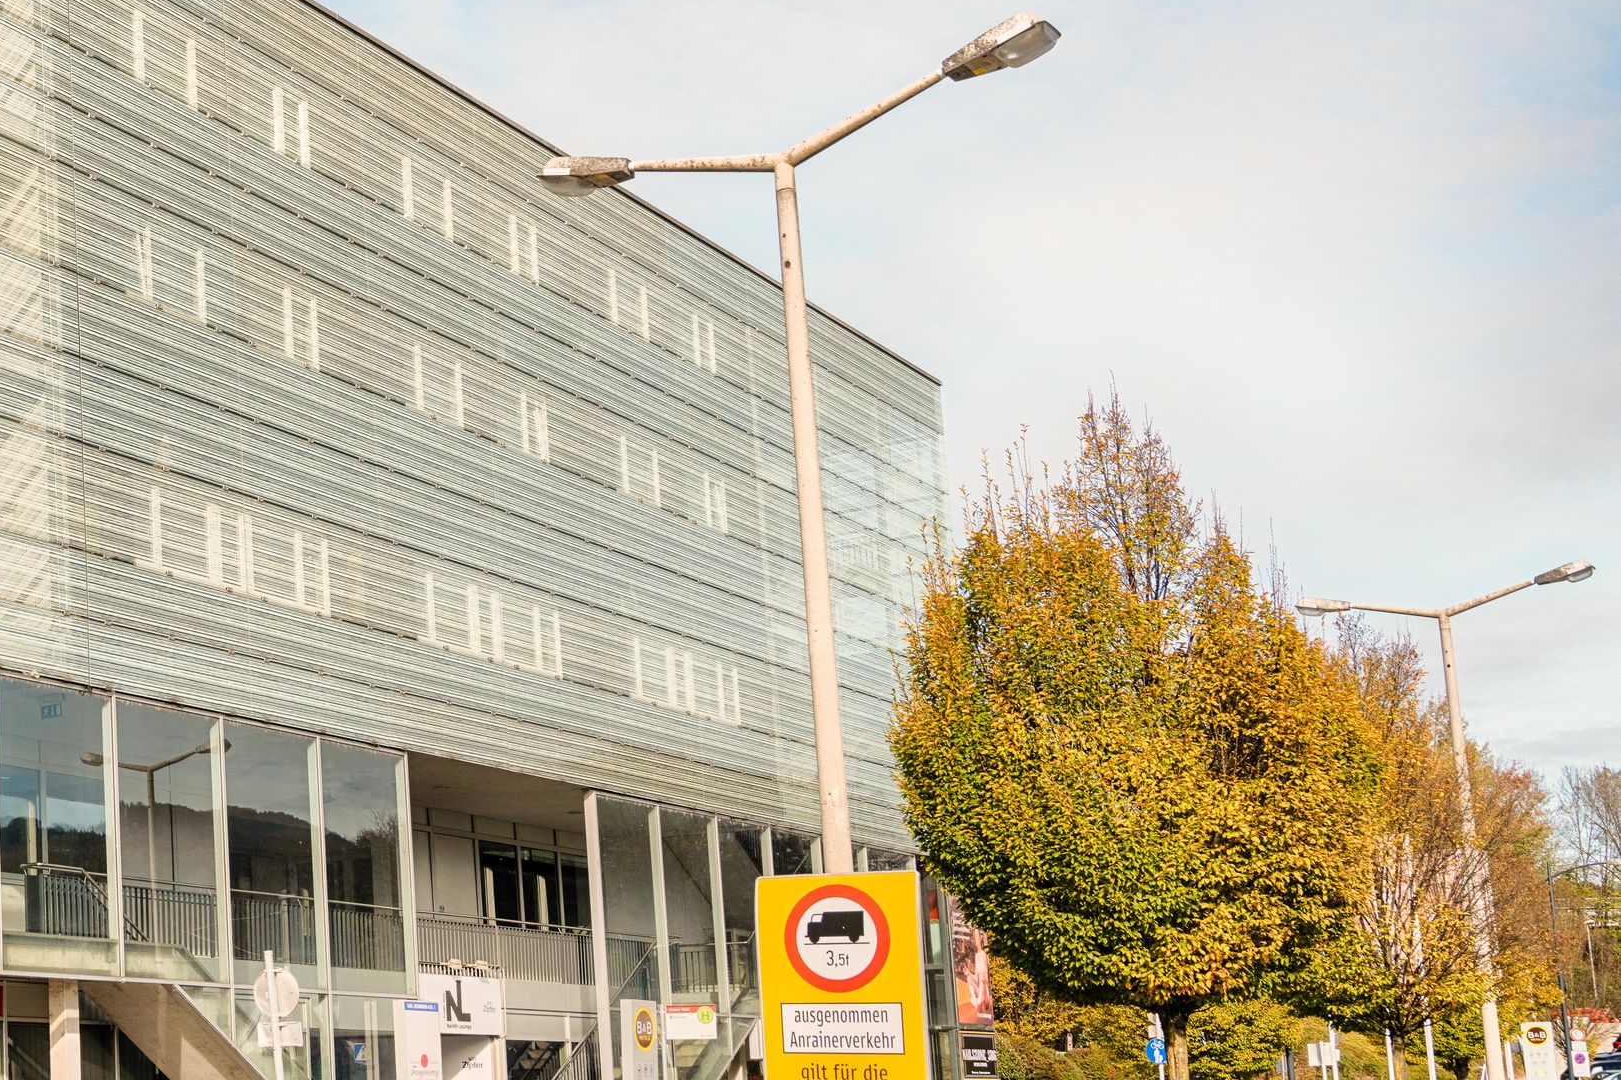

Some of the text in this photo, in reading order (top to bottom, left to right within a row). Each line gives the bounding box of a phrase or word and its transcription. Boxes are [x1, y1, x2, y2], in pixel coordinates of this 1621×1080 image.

[826, 950, 850, 967] 3,5t
[794, 1007, 888, 1027] ausgenommen
[637, 1021, 653, 1035] B&B
[1528, 1031, 1546, 1039] B&B
[790, 1030, 896, 1050] Anrainerverkehr
[801, 1063, 888, 1080] gilt für die
